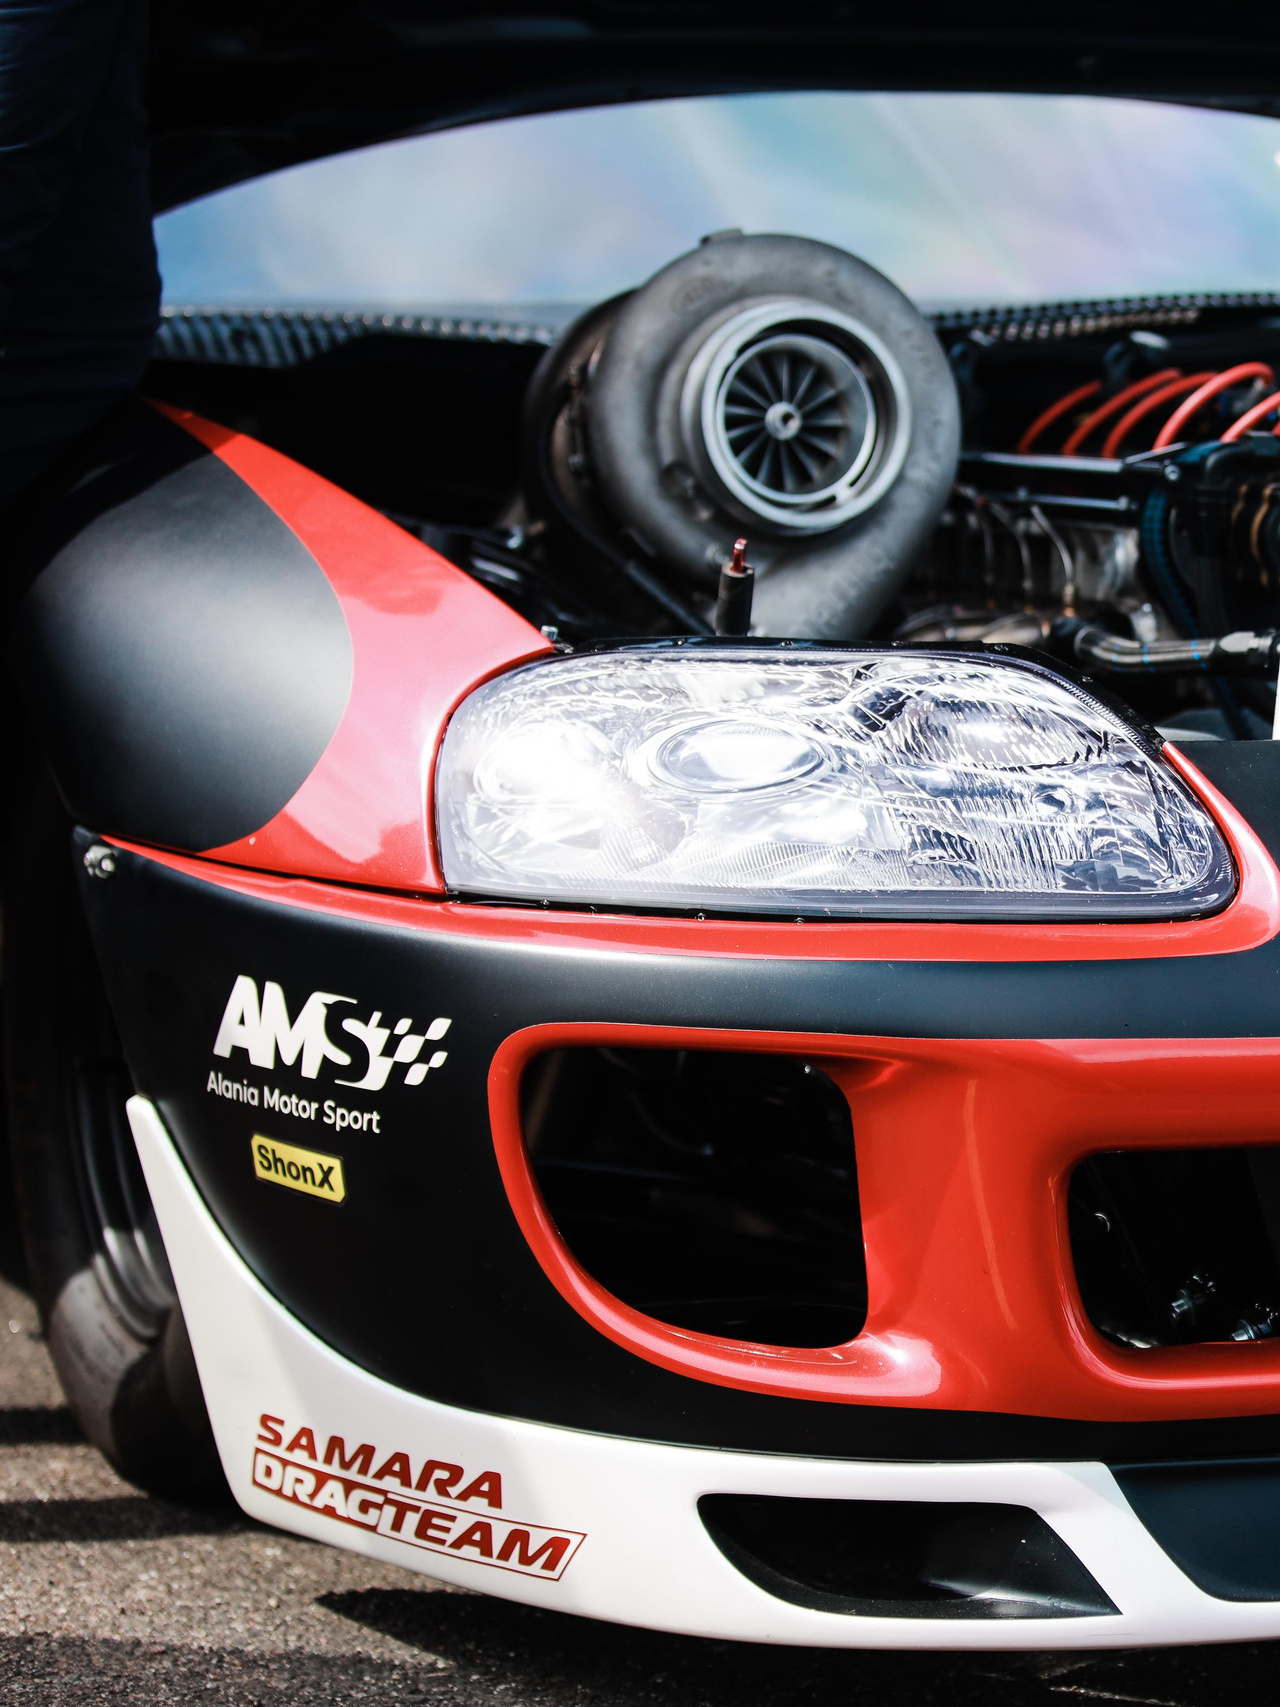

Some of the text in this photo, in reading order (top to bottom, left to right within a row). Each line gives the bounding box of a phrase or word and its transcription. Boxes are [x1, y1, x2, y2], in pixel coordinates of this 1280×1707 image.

[212, 974, 395, 1091] AMS
[206, 1071, 381, 1134] Alania Motor Sport
[257, 1144, 335, 1192] ShonX
[257, 1413, 503, 1510] SAMARA
